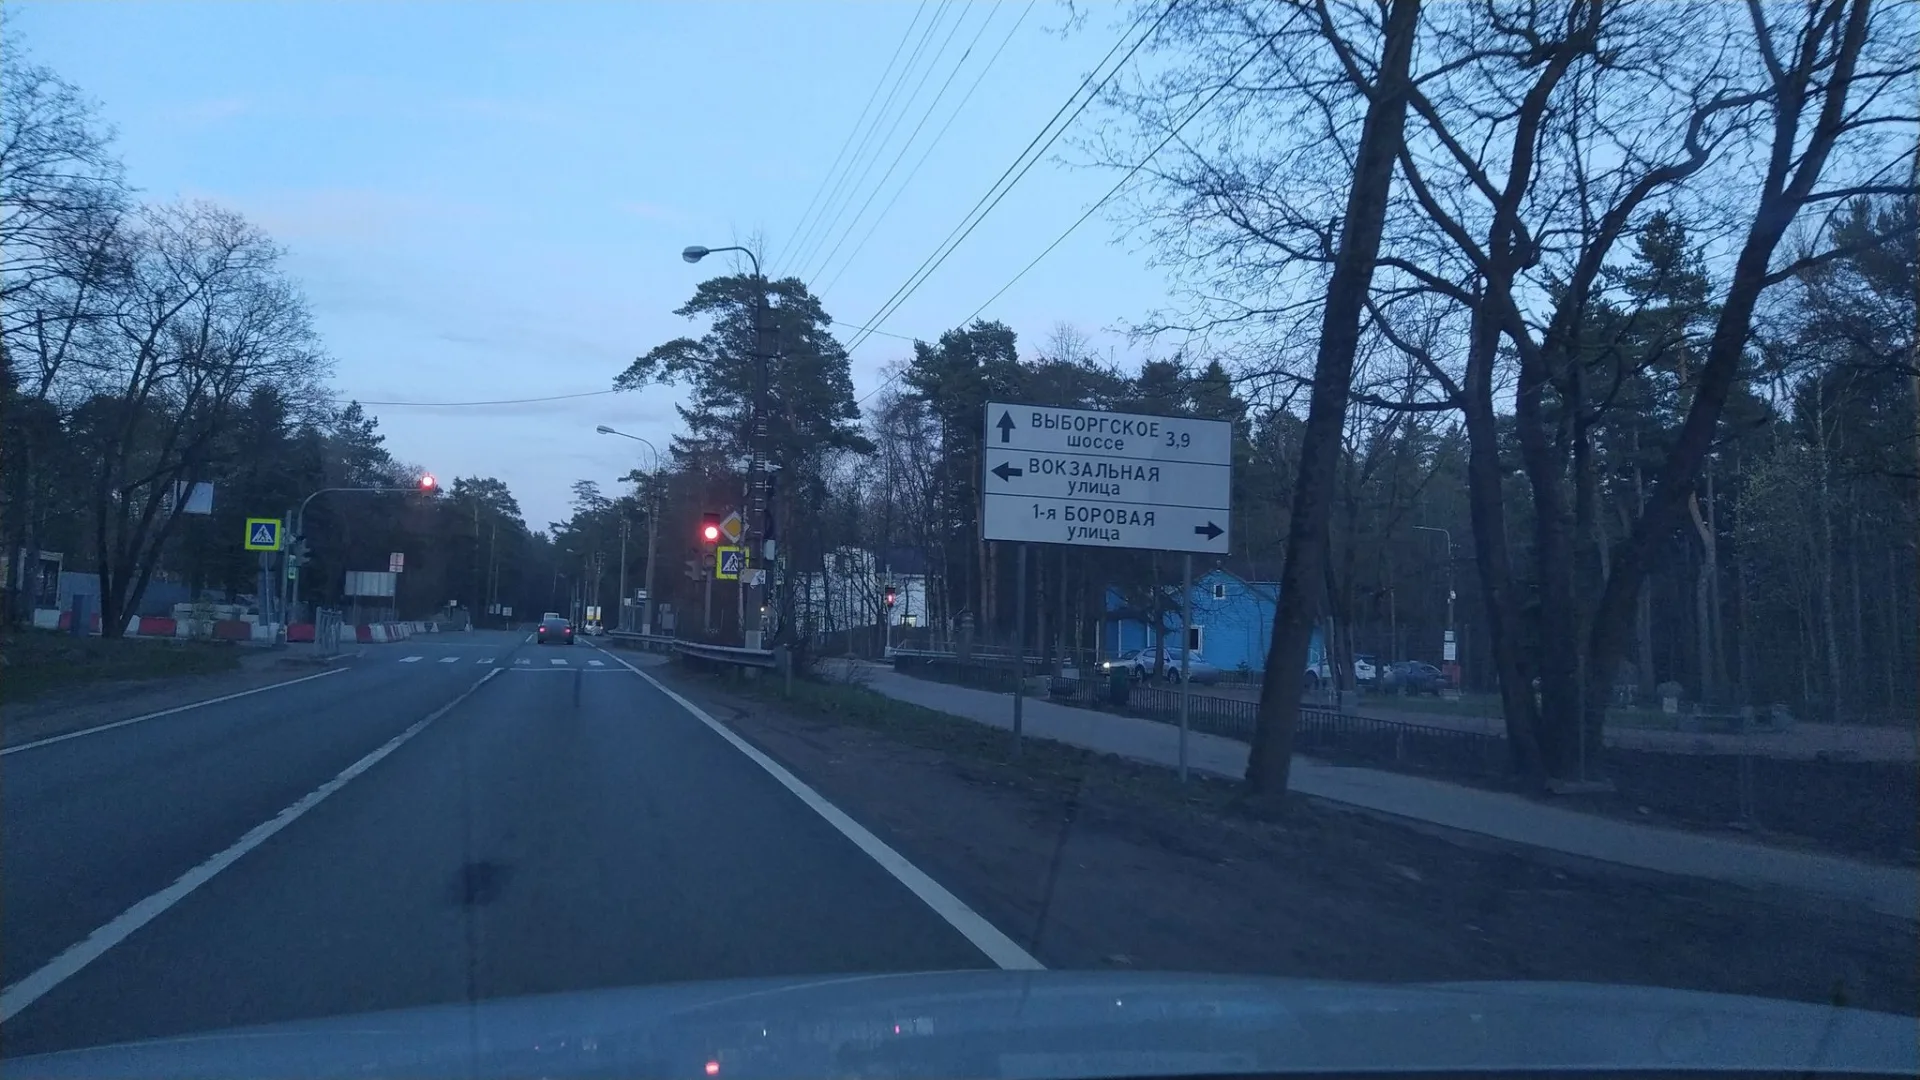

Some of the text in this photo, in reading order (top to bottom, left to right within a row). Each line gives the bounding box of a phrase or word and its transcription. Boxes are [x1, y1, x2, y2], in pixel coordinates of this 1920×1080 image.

[1031, 412, 1160, 438] ВЫБОРГСКОЕ
[1067, 434, 1124, 451] шоссе
[1166, 431, 1191, 449] 3,9
[1029, 458, 1160, 482] ВОКЗАЛЬНАЯ
[1067, 479, 1120, 496] улица
[1033, 504, 1155, 527] 1-я БОРОВАЯ
[1067, 525, 1120, 541] улица
